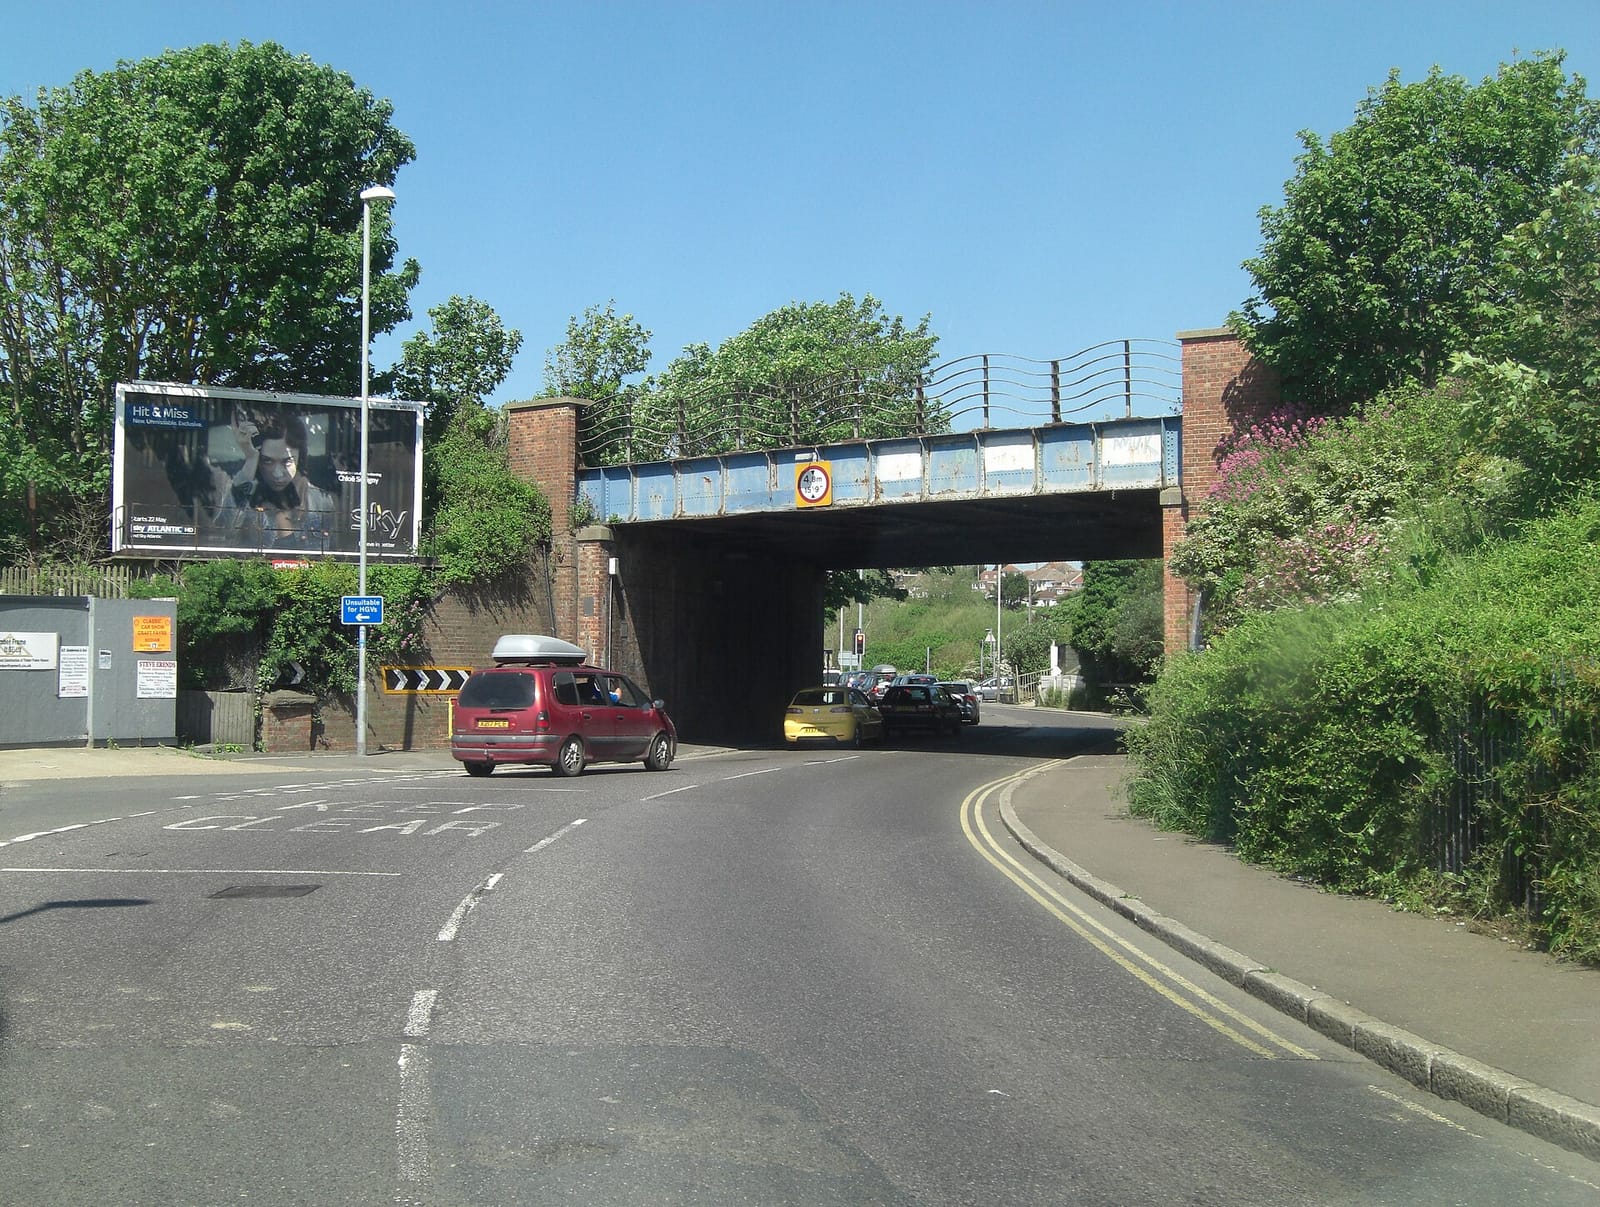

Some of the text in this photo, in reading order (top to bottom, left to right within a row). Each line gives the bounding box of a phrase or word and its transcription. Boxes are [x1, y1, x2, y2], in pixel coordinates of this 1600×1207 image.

[133, 406, 189, 419] Hit & Miss
[147, 525, 183, 533] ATLANTIC
[276, 799, 526, 816] KEEP
[162, 814, 504, 837] CLEAR
